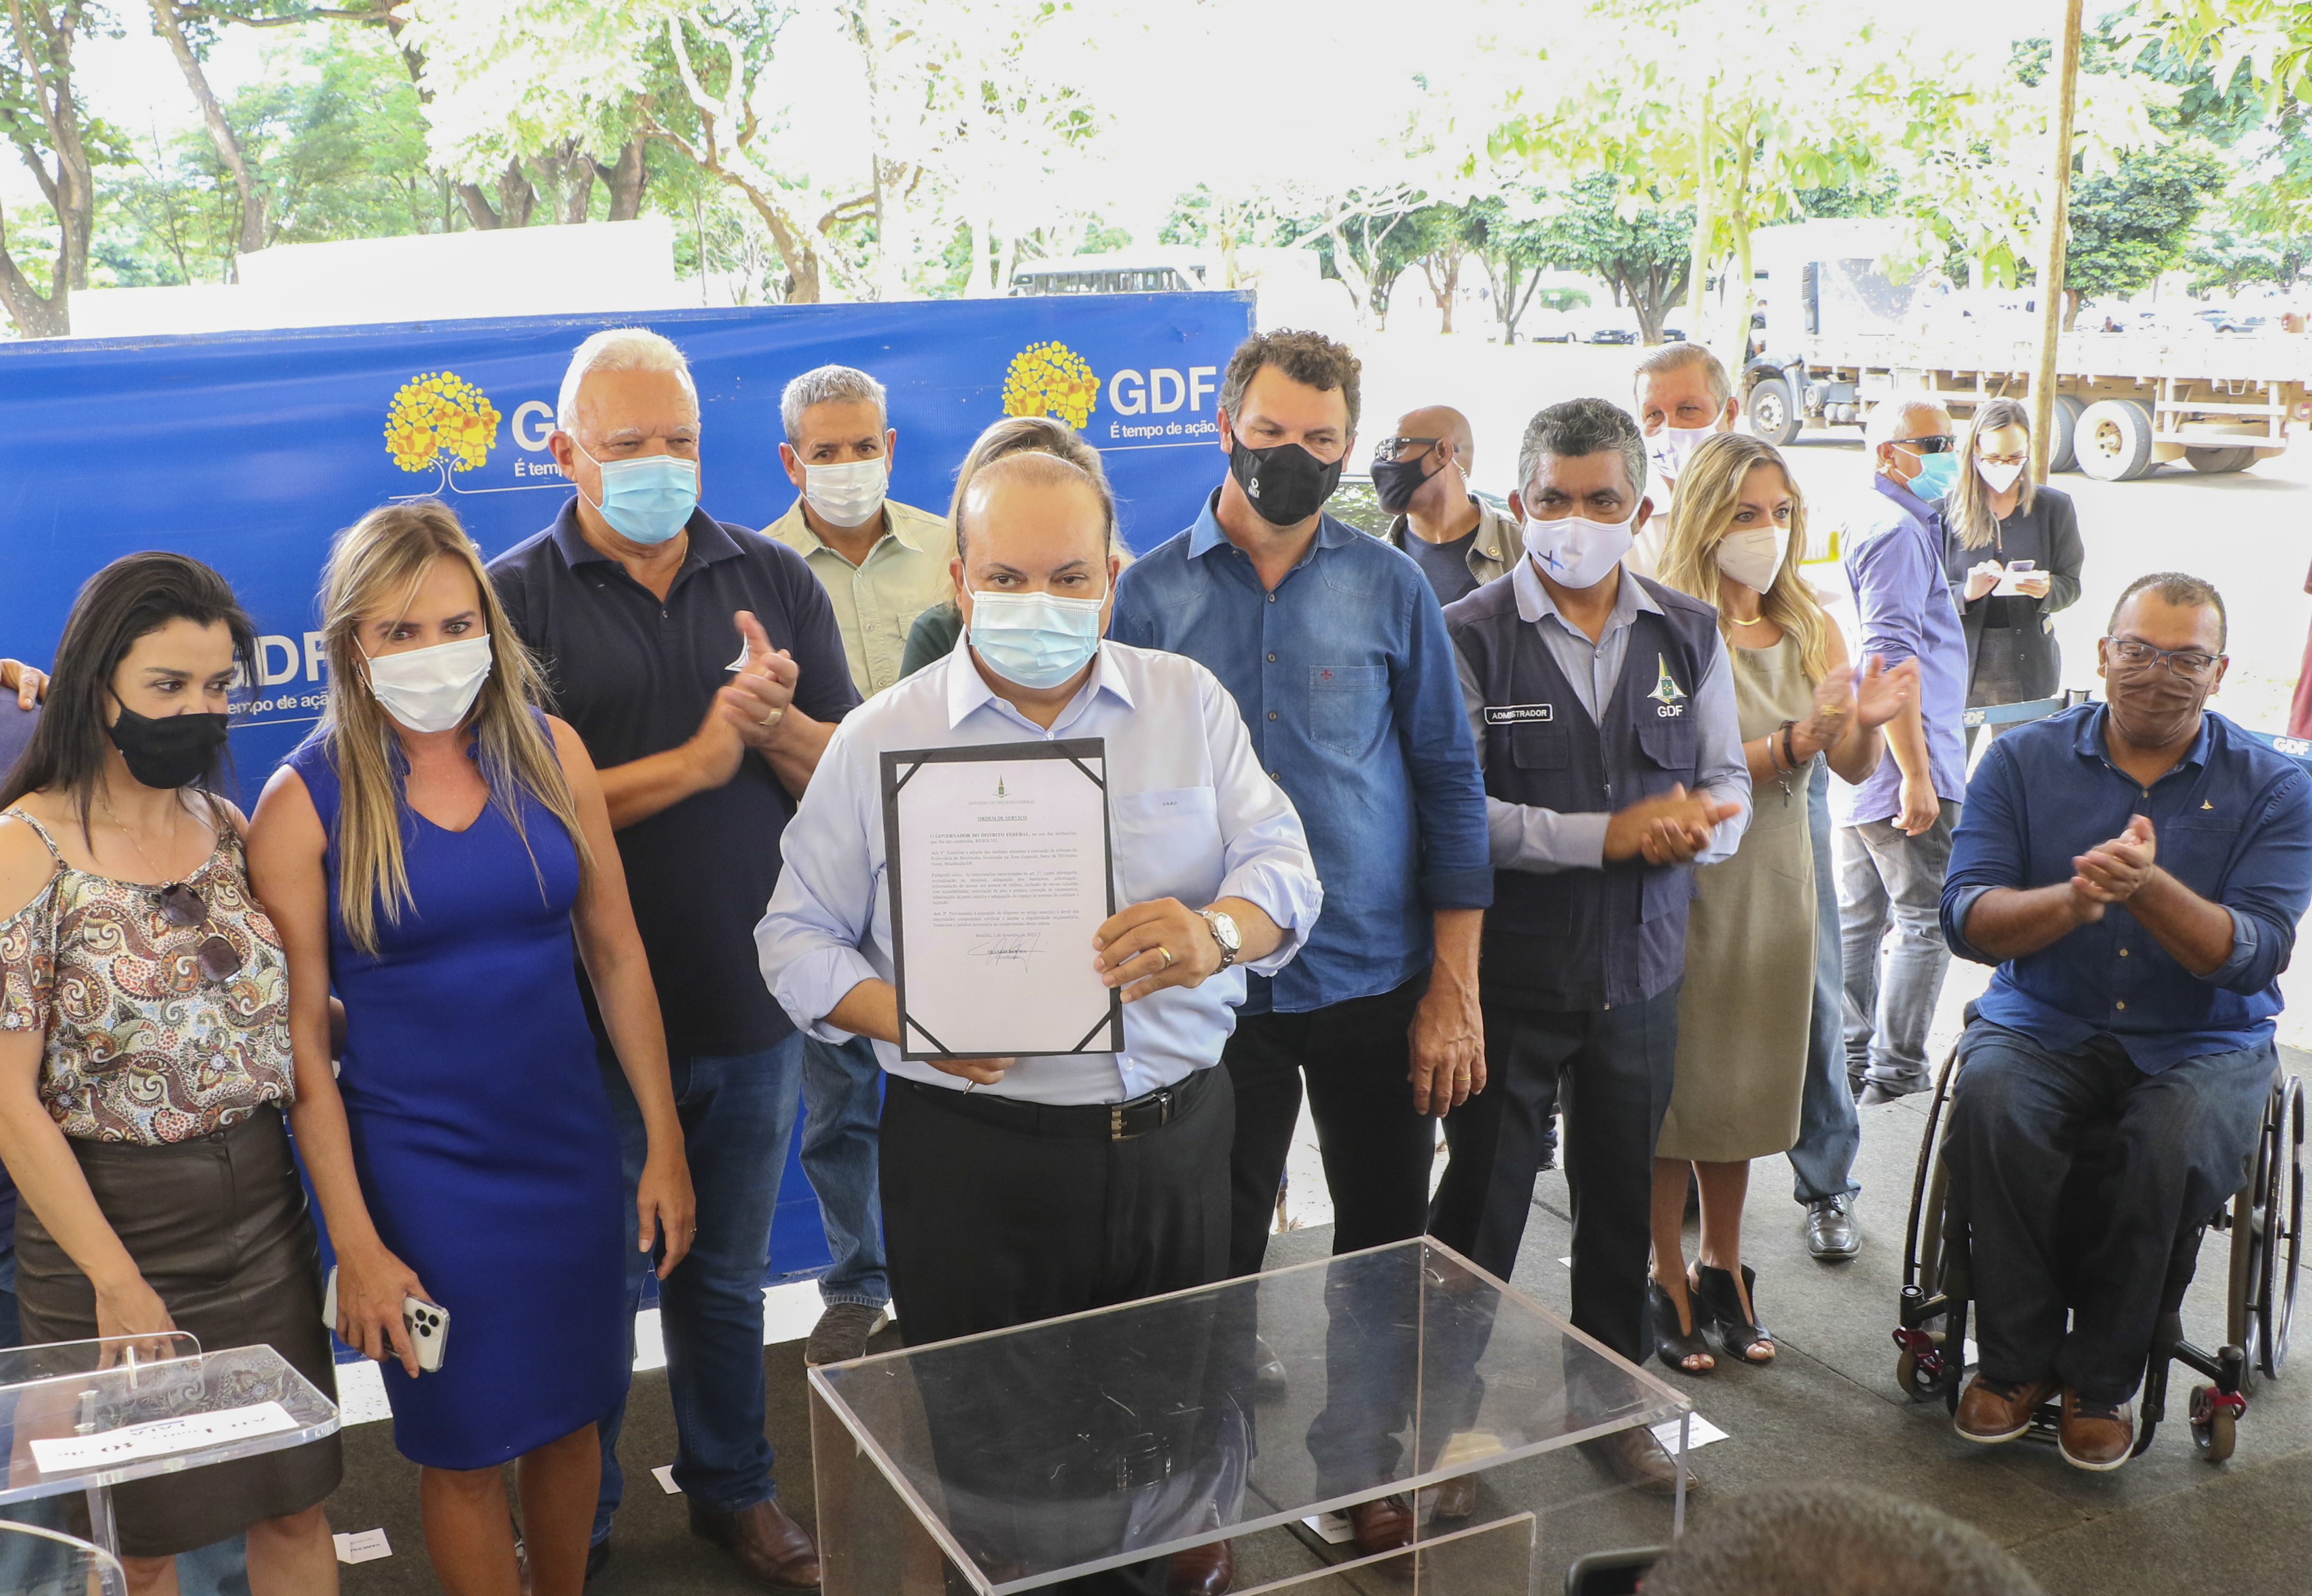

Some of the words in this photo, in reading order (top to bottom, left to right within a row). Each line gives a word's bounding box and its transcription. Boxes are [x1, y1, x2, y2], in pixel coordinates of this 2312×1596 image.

[1109, 366, 1217, 416] GDF
[1110, 421, 1120, 438] É
[1122, 425, 1163, 439] tempo
[1166, 422, 1182, 435] de
[1185, 420, 1218, 437] ação.
[514, 458, 526, 477] É
[228, 700, 273, 716] empo
[276, 695, 298, 710] de
[301, 691, 329, 710] açã
[1657, 705, 1683, 718] GDF
[1492, 710, 1547, 720] ADMISTRADOR
[2273, 737, 2309, 756] GDF
